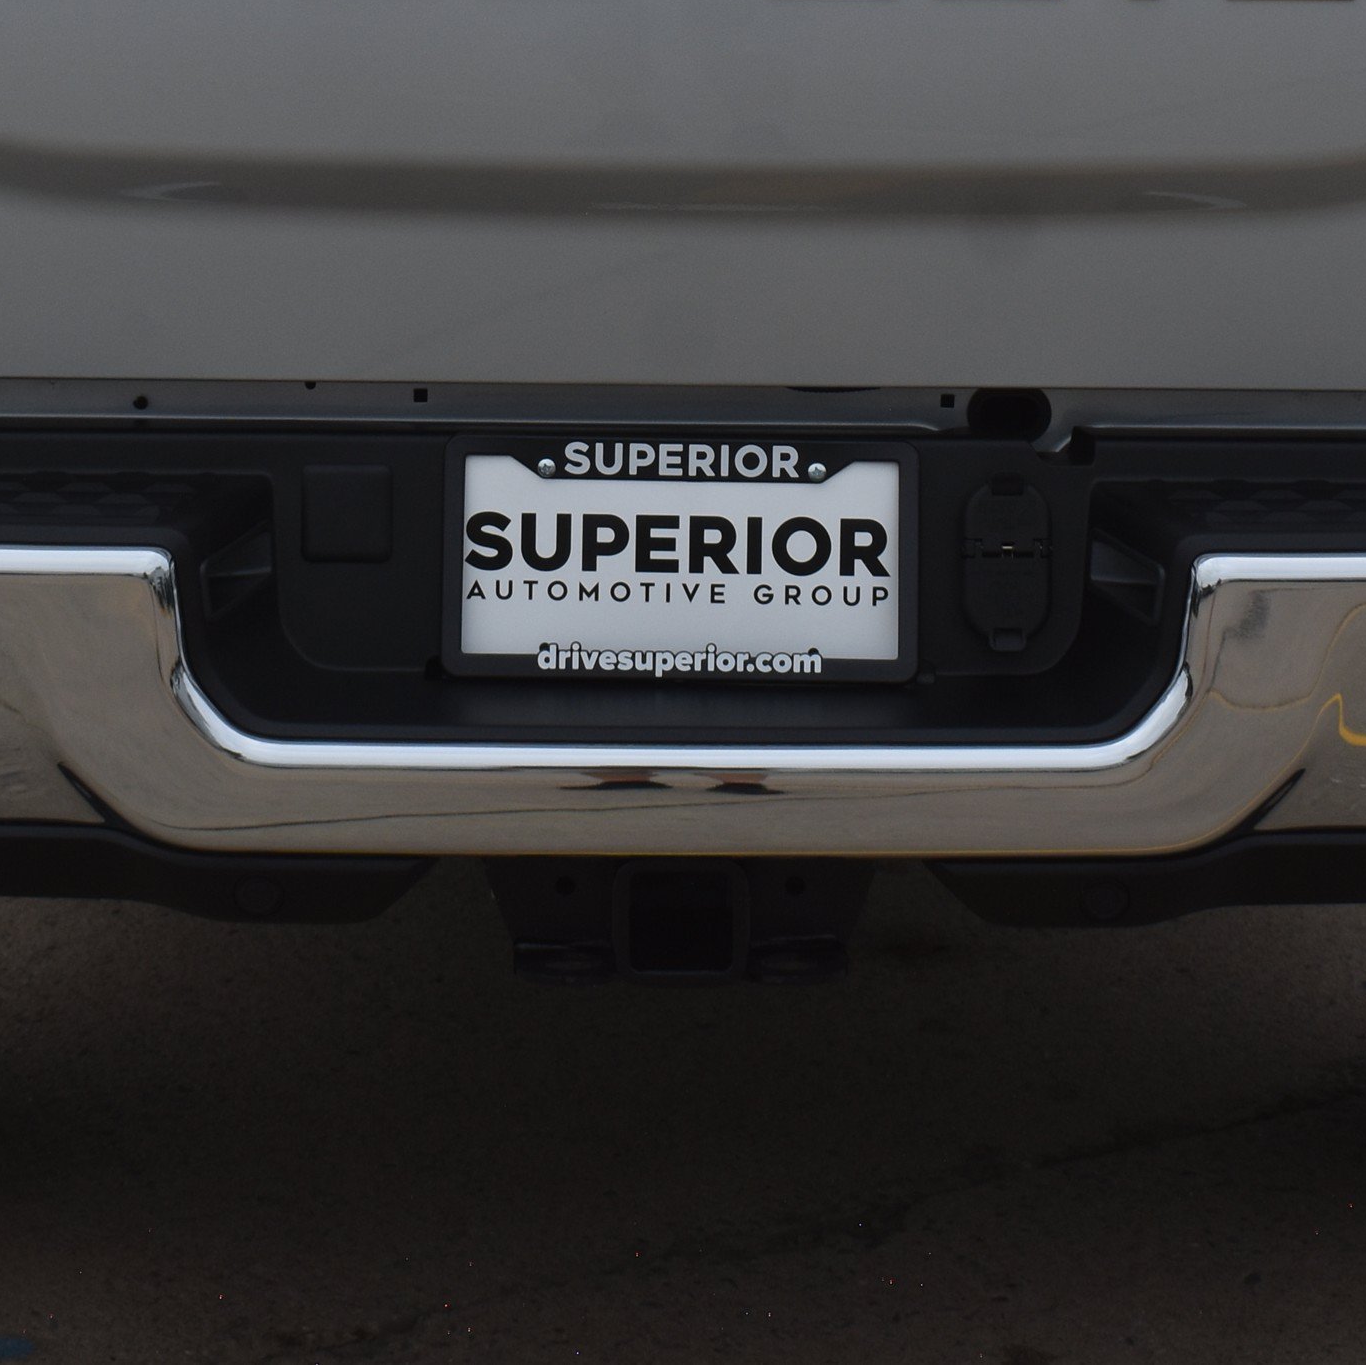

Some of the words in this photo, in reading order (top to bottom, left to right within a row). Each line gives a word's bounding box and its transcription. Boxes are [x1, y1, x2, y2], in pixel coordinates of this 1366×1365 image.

[563, 441, 801, 479] SUPERIOR
[463, 510, 892, 578] SUPERIOR
[466, 579, 727, 605] AUTOMOTIVE
[753, 584, 890, 607] GROUP
[537, 642, 823, 678] drivesuperior.com
